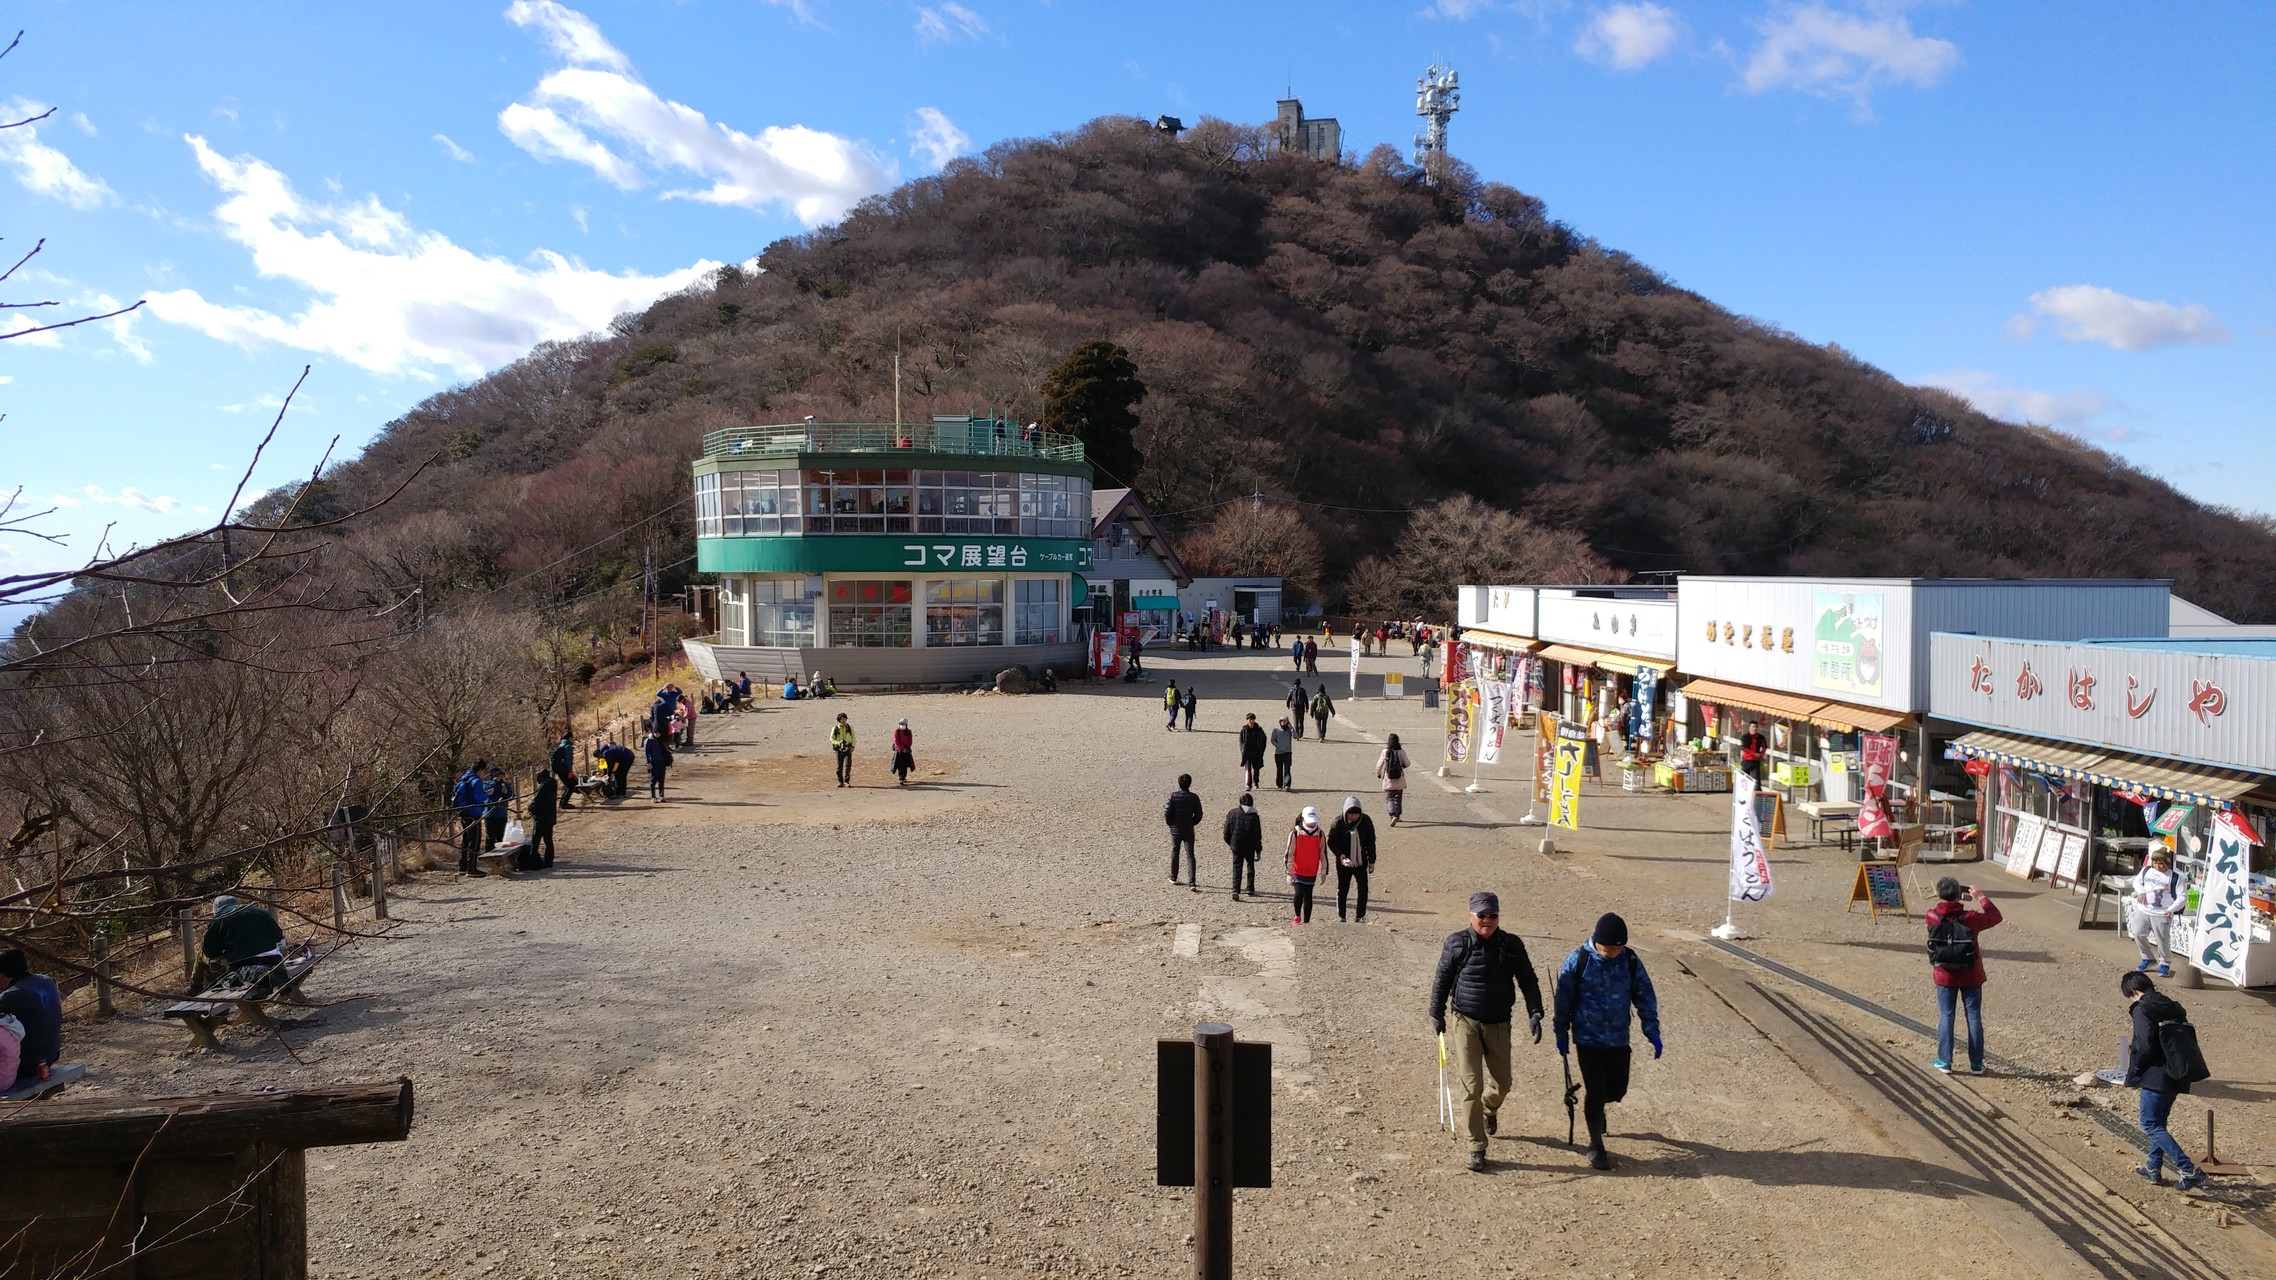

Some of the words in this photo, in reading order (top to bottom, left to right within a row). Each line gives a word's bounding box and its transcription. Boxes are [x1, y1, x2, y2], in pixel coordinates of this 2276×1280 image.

[903, 544, 1028, 567] コマ展望台
[1970, 653, 2228, 728] たかはしや
